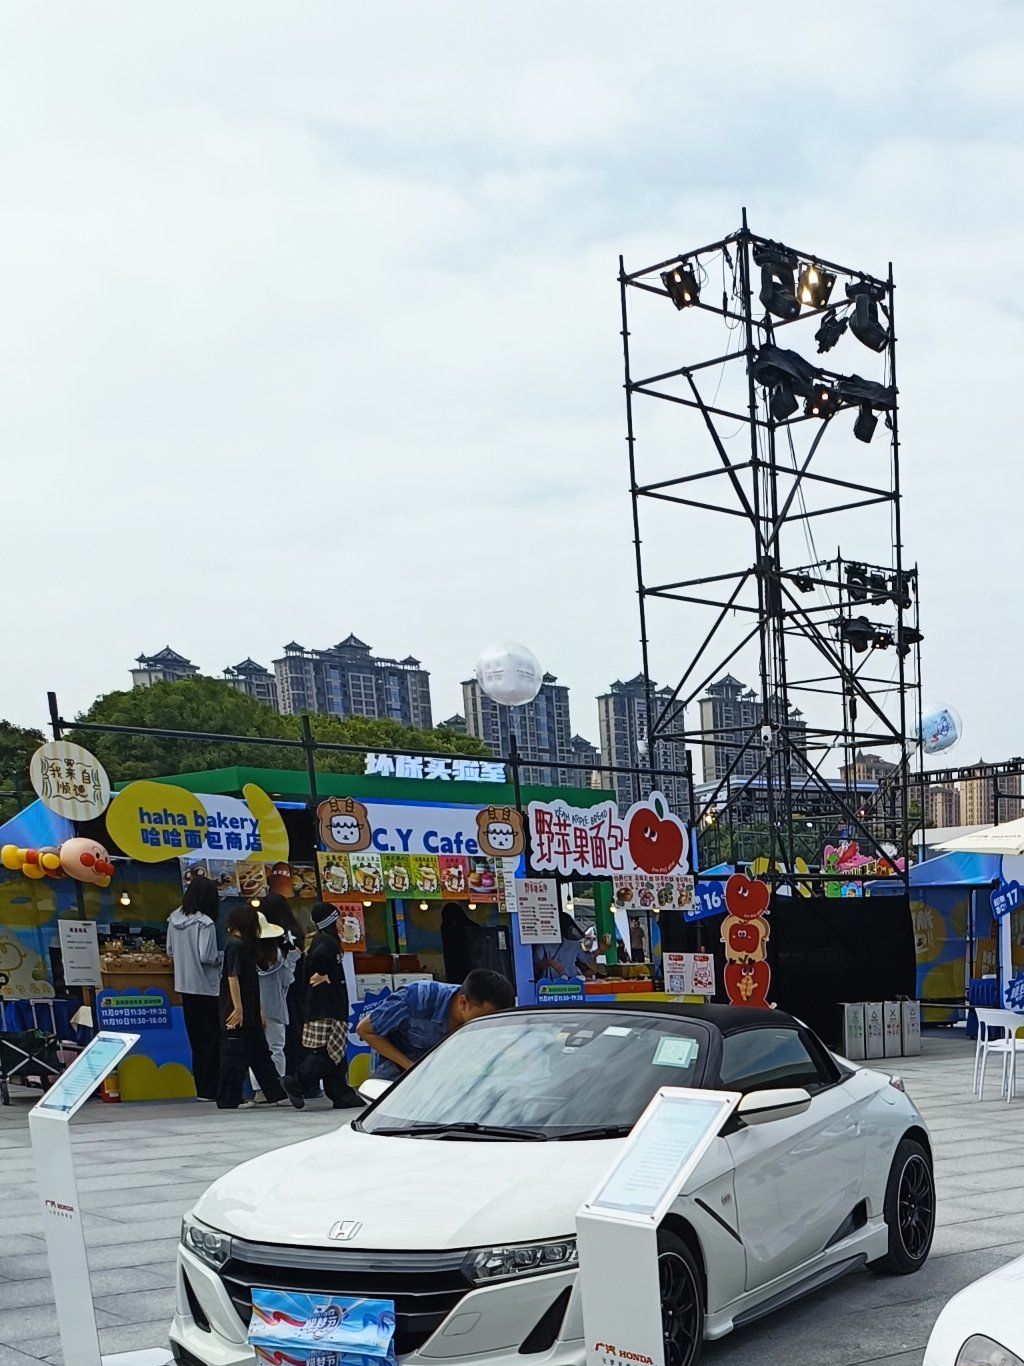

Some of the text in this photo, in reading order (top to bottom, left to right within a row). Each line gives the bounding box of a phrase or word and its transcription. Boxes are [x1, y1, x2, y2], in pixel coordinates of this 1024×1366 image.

[364, 753, 507, 783] 环保实验室
[138, 806, 260, 835] haha bakery
[554, 806, 608, 827] YEAH APPLE BREAD
[141, 827, 263, 852] 哈哈面包商店
[372, 827, 479, 855] C.Y Cafe
[534, 807, 625, 871] 野苹果面包
[703, 891, 722, 910] 16
[1006, 887, 1018, 906] 17
[619, 1350, 654, 1364] HONDA
